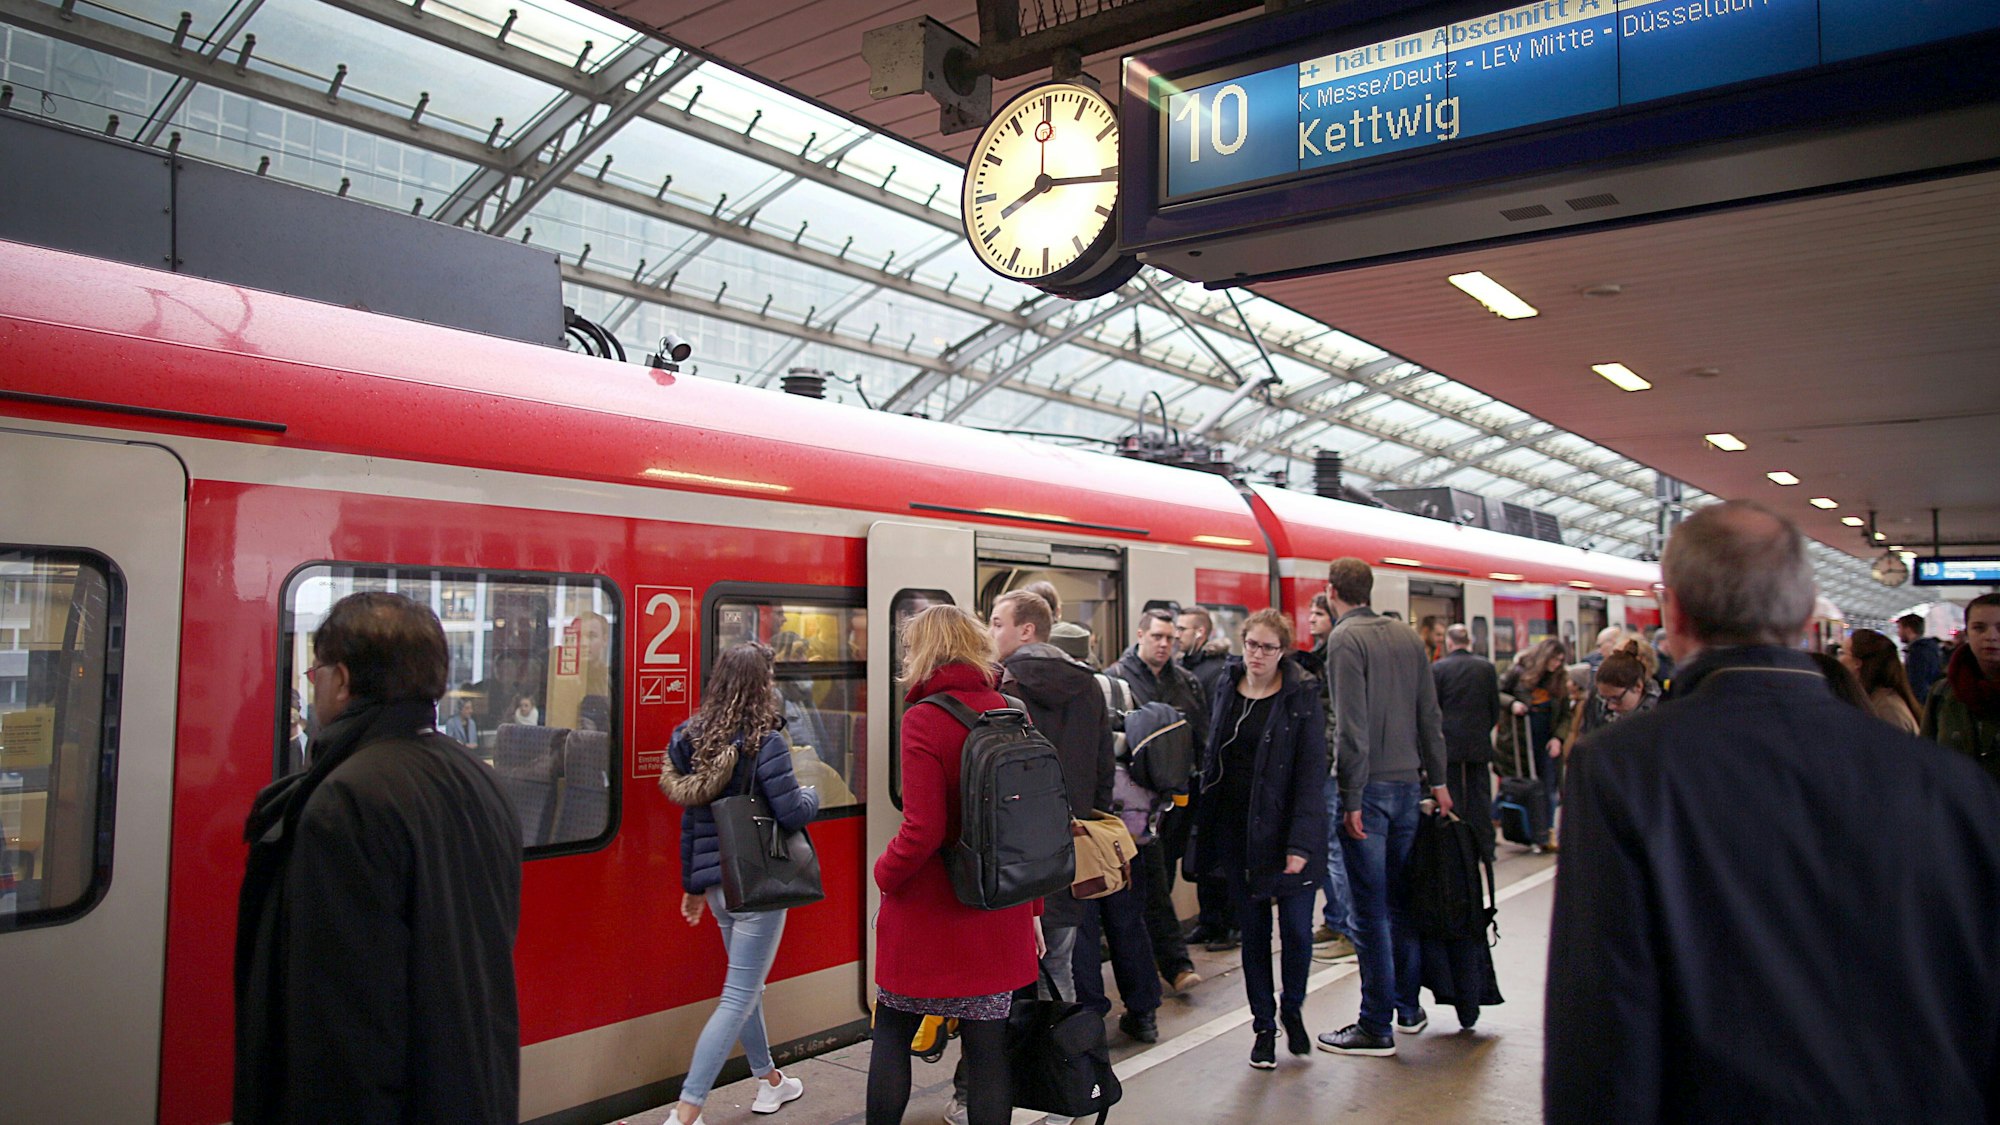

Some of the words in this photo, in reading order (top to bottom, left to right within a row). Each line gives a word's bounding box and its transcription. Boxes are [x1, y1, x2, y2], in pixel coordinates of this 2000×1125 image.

[1299, 92, 1311, 113] K
[1318, 61, 1457, 108] Messe/Deutz
[1482, 43, 1523, 70] LEV
[1530, 27, 1594, 59] Mitte
[1623, 0, 1768, 37] Düsseldo
[1335, 44, 1386, 73] hält
[1395, 38, 1422, 58] im
[1431, 0, 1569, 49] Abschnitt
[1175, 84, 1248, 163] 10
[1298, 94, 1460, 160] Kettwig
[644, 593, 680, 664] 2
